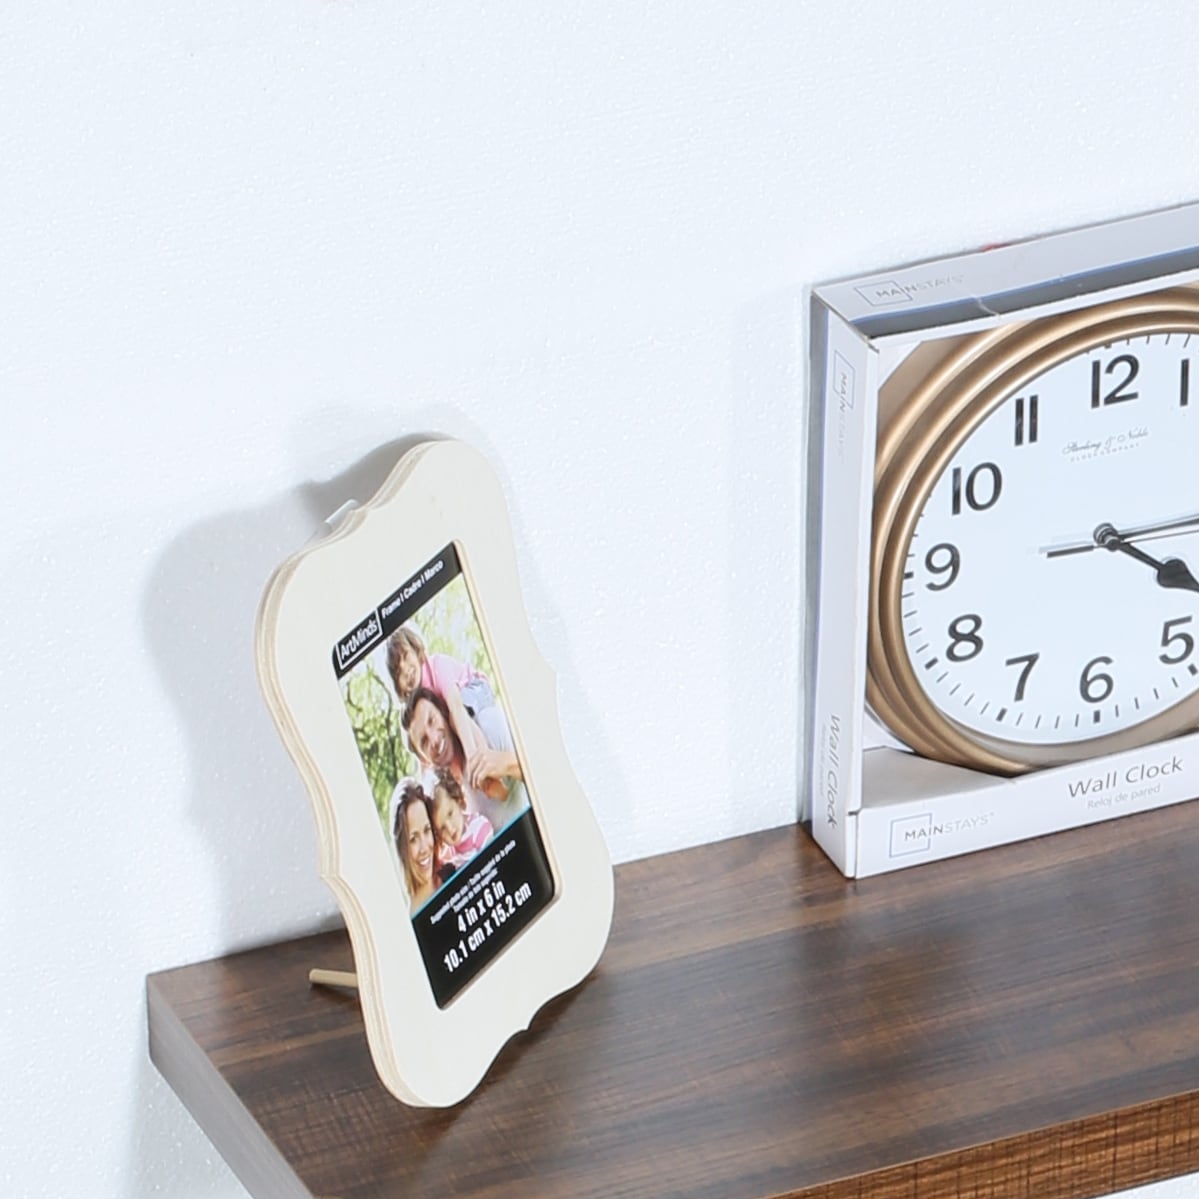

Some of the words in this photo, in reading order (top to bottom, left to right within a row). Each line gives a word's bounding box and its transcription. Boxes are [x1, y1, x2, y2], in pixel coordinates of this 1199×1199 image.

[1091, 354, 1139, 409] 12
[1180, 358, 1190, 407] 1
[1014, 394, 1039, 446] 11
[951, 462, 1003, 516] 10
[924, 543, 961, 591] 9
[381, 597, 401, 619] Frame
[340, 619, 377, 660] ArtMinds
[944, 614, 984, 663] 8
[1158, 616, 1195, 665] 5
[1004, 653, 1040, 702] 7
[1078, 656, 1114, 704] 6
[829, 714, 842, 768] Wall
[826, 769, 839, 829] Clock
[1068, 770, 1118, 798] Wall
[1125, 755, 1184, 784] Clock
[904, 814, 989, 841] MAINSTAYS
[444, 940, 468, 972] 10.1
[468, 930, 486, 951] cm
[484, 920, 493, 936] x
[491, 895, 516, 927] 15.2
[514, 883, 532, 906] cm
[458, 914, 466, 932] 4
[465, 908, 478, 926] in
[477, 899, 486, 915] x
[484, 888, 494, 907] 6
[492, 881, 505, 900] in
